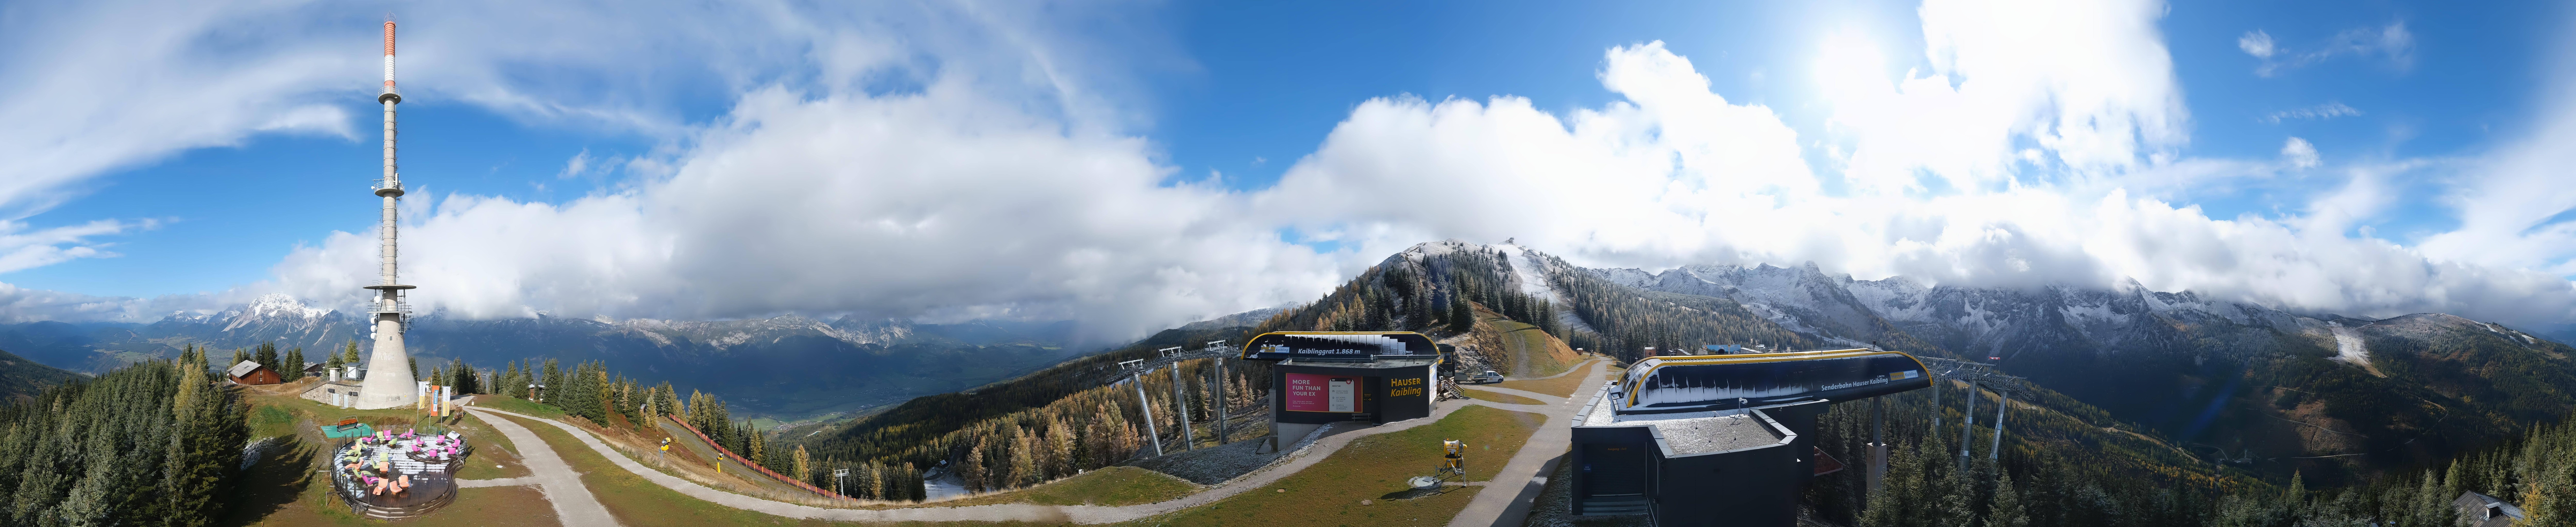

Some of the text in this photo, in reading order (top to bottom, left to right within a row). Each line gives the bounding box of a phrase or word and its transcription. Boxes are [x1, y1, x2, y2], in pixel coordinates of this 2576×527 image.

[1391, 378, 1421, 387] HAUSER
[1821, 383, 1852, 391] Senderbahn
[1391, 387, 1421, 397] Kaibling
